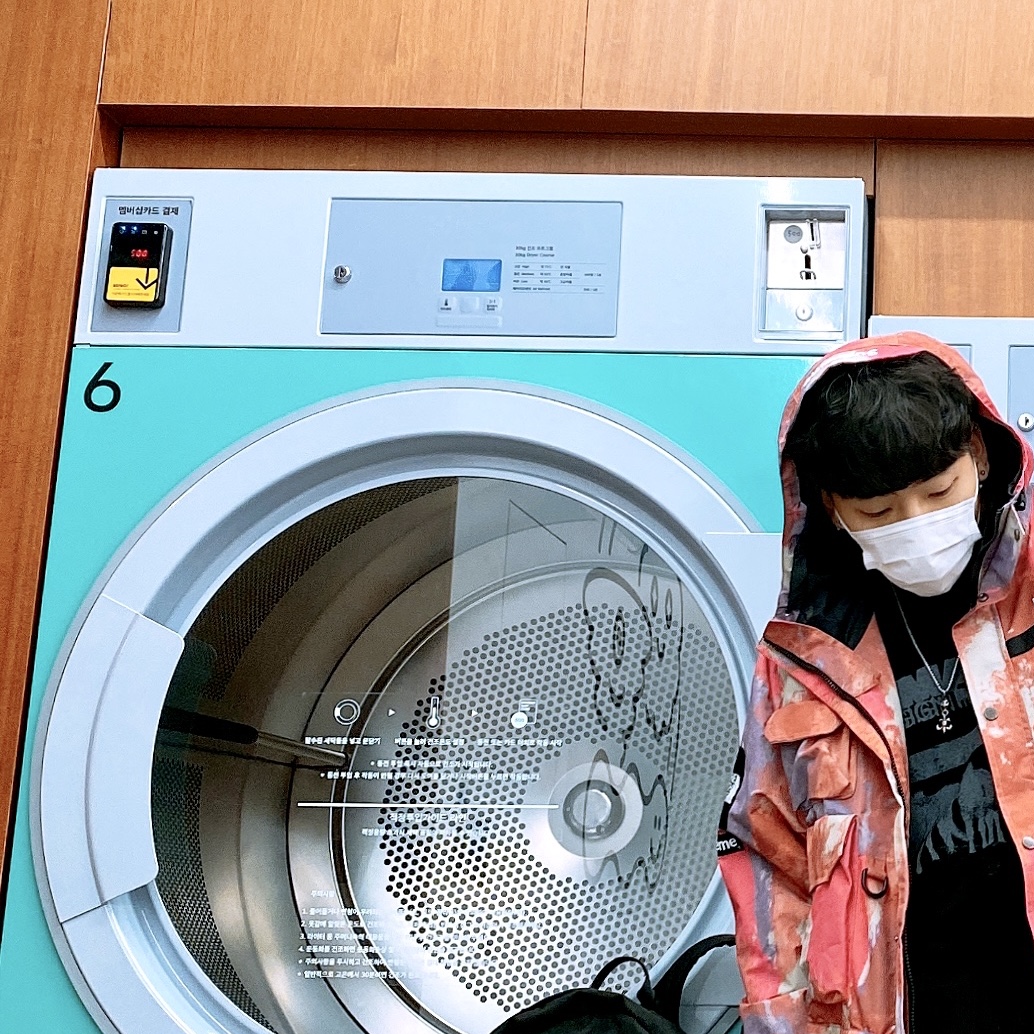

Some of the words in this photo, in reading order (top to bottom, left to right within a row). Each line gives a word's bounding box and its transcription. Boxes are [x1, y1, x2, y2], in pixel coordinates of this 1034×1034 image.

[118, 206, 160, 215] 멤버십카드
[163, 206, 179, 215] 결제
[83, 362, 122, 413] 6
